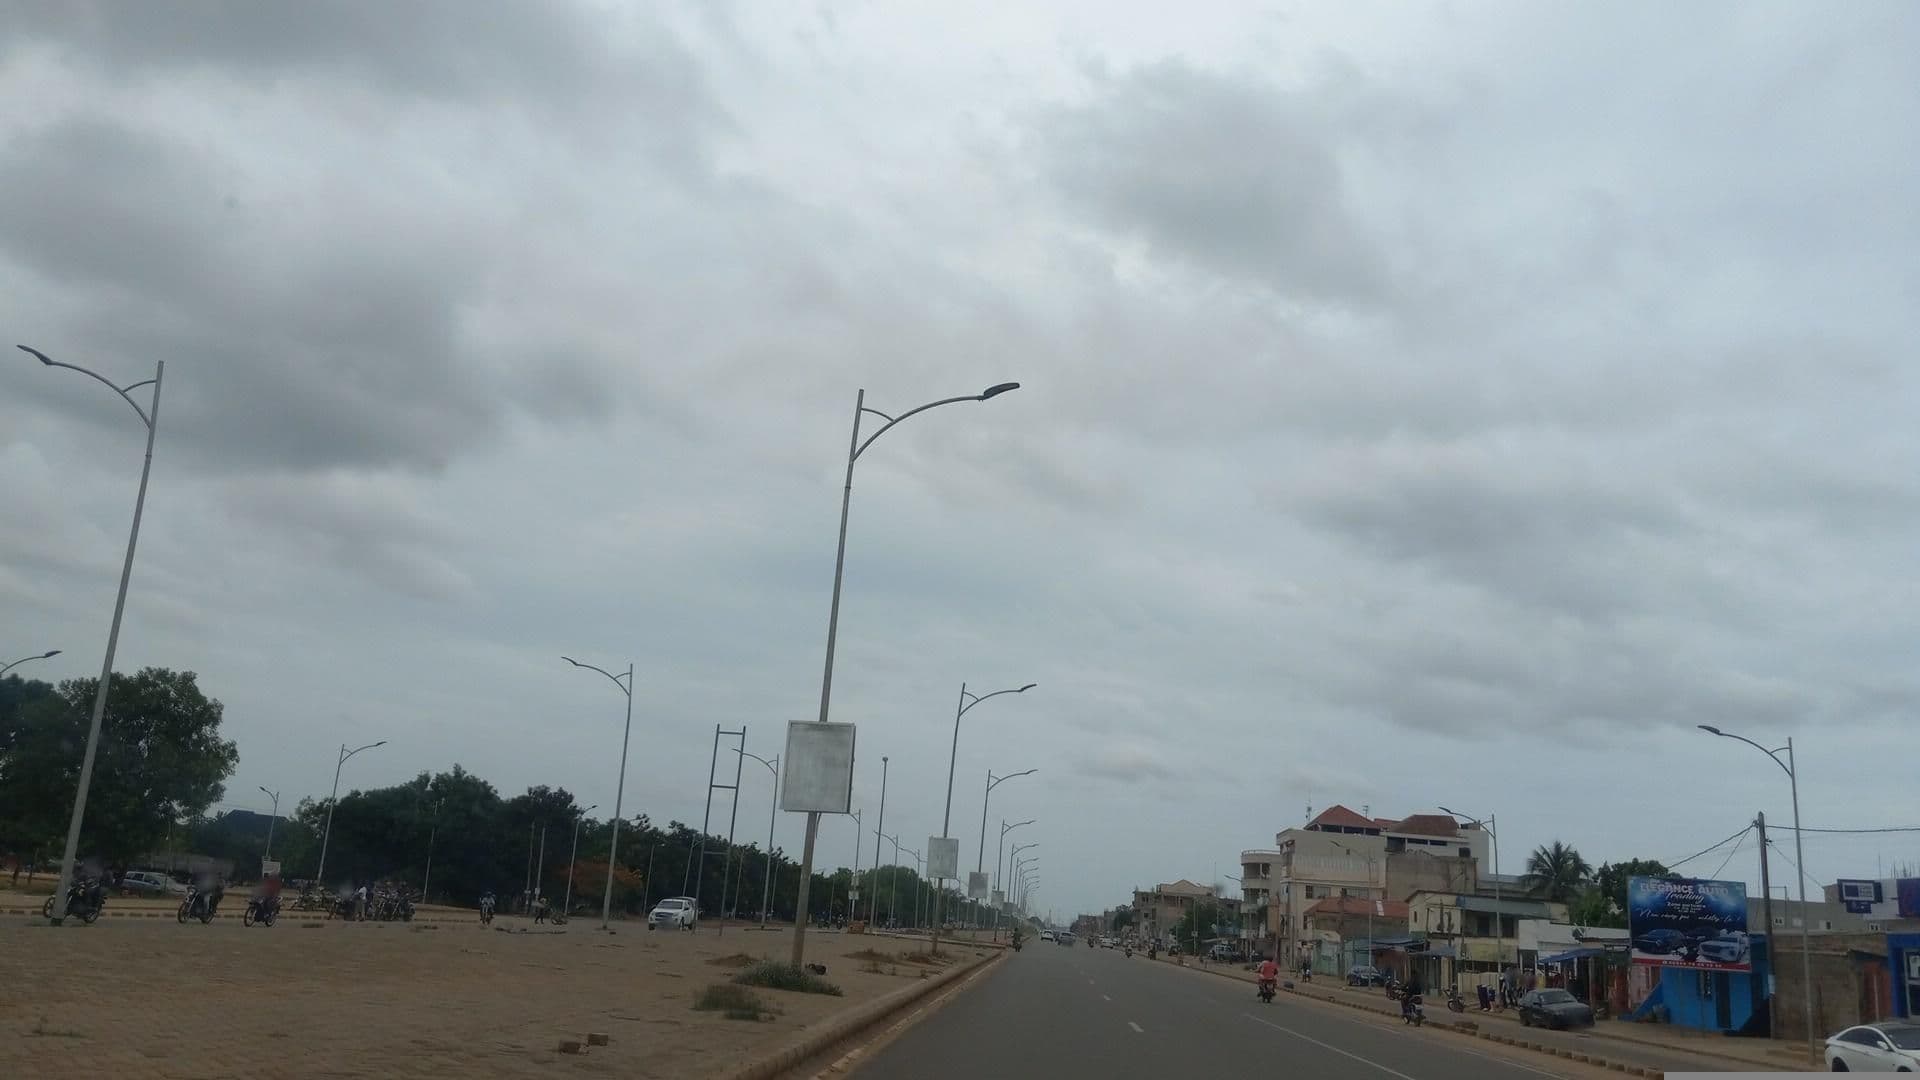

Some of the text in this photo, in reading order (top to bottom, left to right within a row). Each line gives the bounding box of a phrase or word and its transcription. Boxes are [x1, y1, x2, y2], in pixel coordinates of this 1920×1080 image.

[1640, 881, 1729, 896] ELEGANCE AUTO
[1665, 891, 1705, 904] Trading
